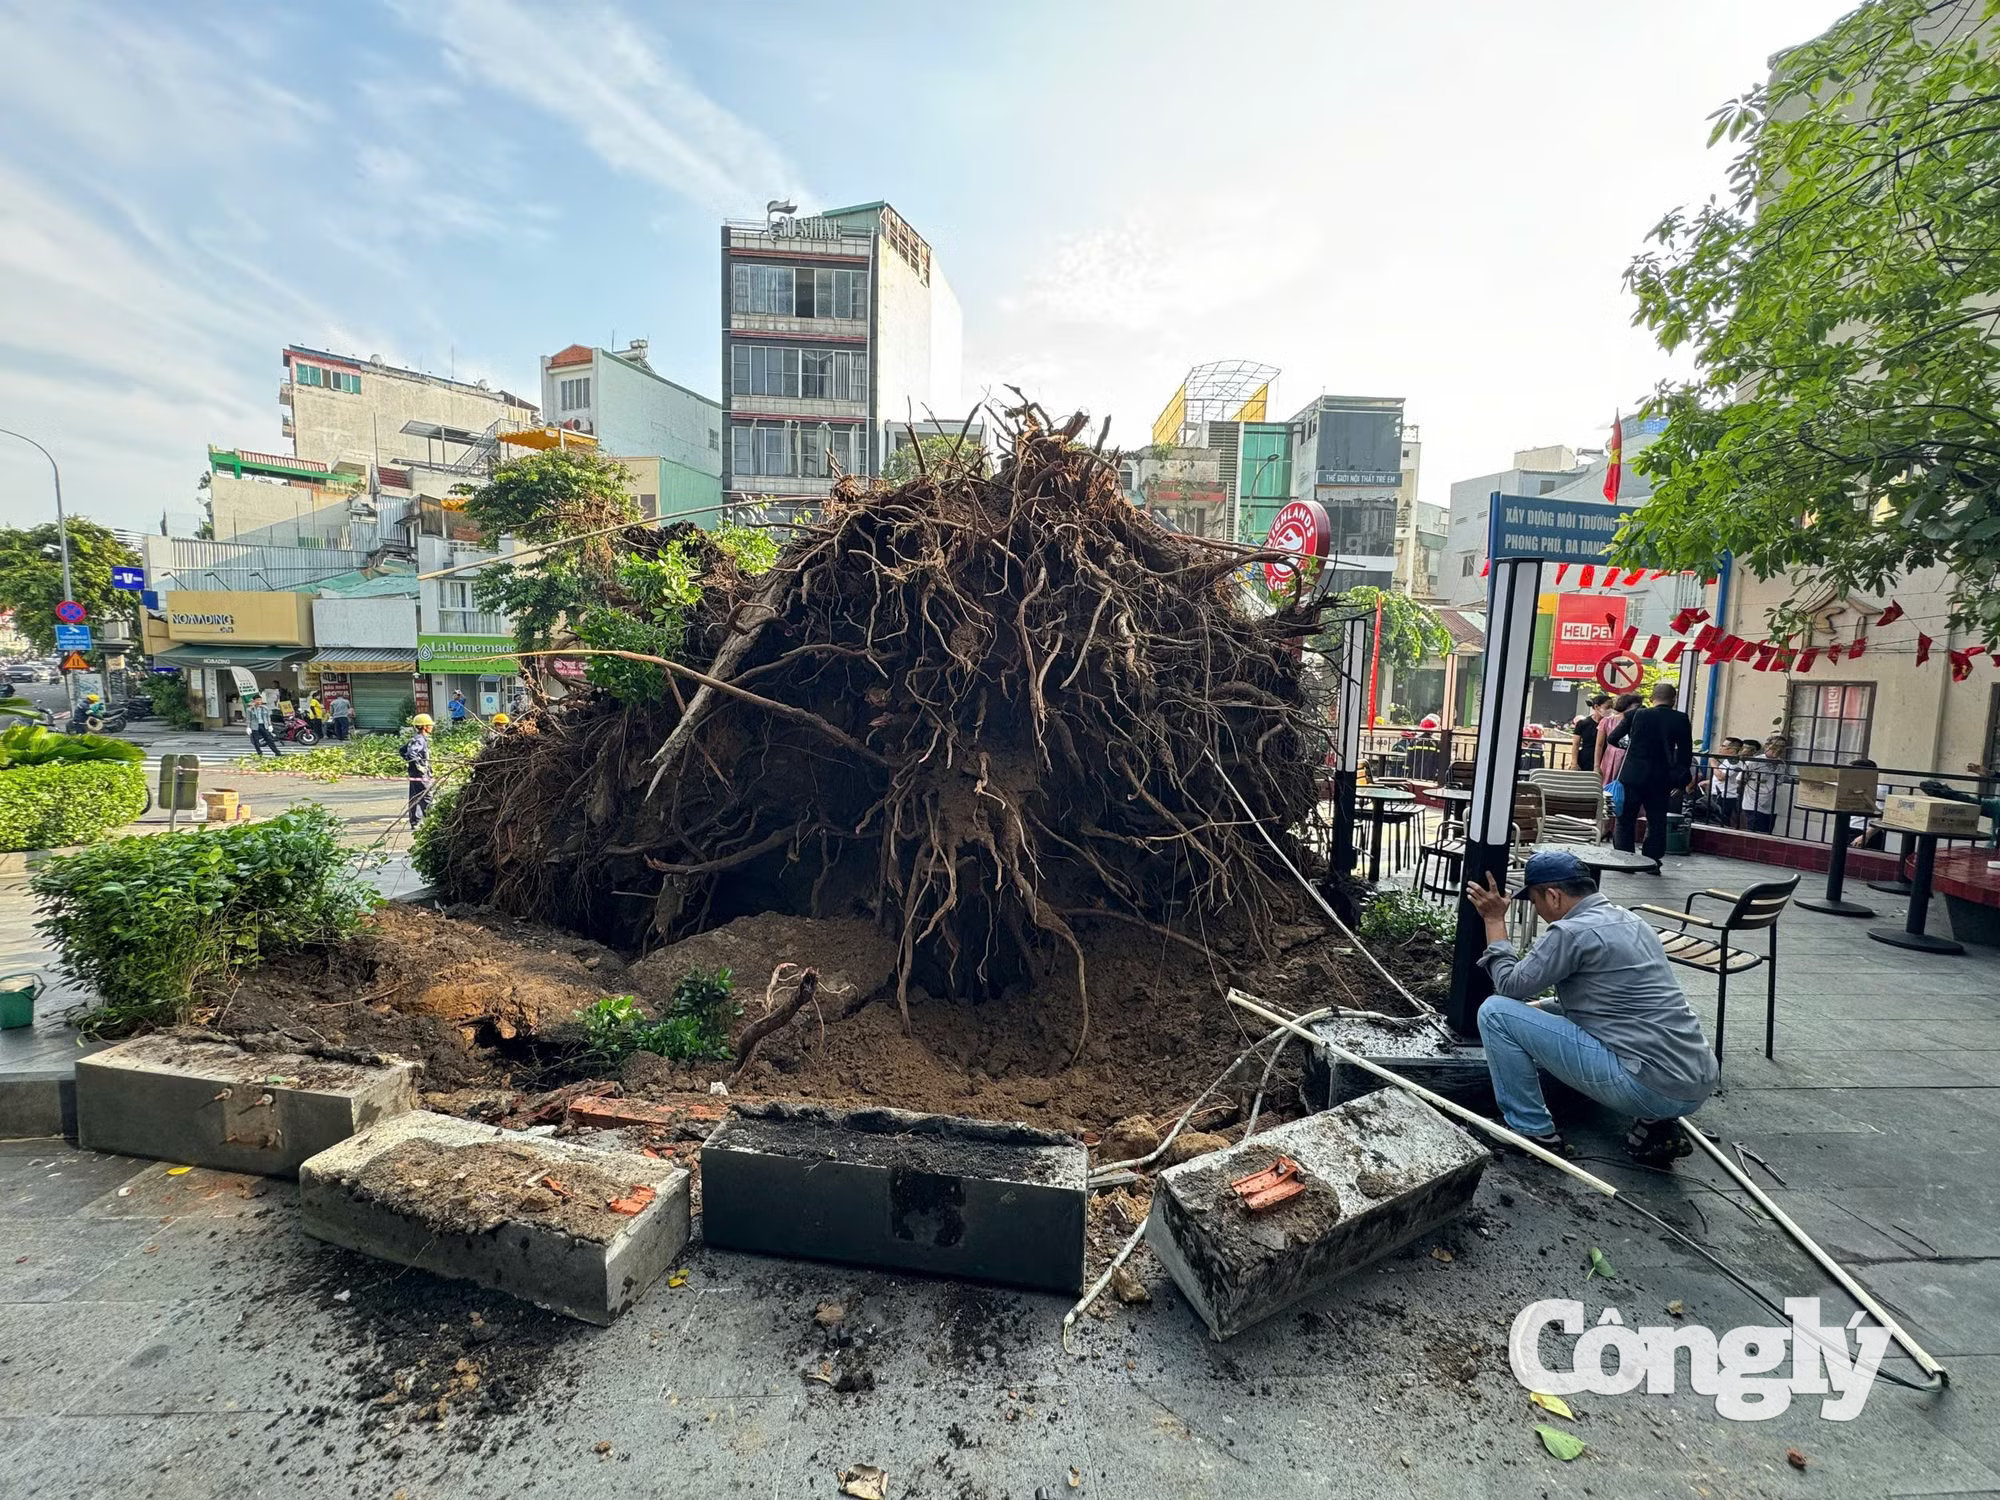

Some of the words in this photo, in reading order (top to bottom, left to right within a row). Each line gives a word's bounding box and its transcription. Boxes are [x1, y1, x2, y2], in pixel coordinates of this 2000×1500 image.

[800, 217, 841, 240] SHINE
[1505, 506, 1525, 524] XÂY
[1527, 509, 1554, 528] DỰNG
[1556, 511, 1576, 529] MÔI
[1504, 534, 1539, 551] PHONG
[1565, 540, 1579, 554] ĐA
[172, 613, 234, 625] NOMADING
[432, 641, 446, 652] La
[447, 641, 516, 654] Homemade
